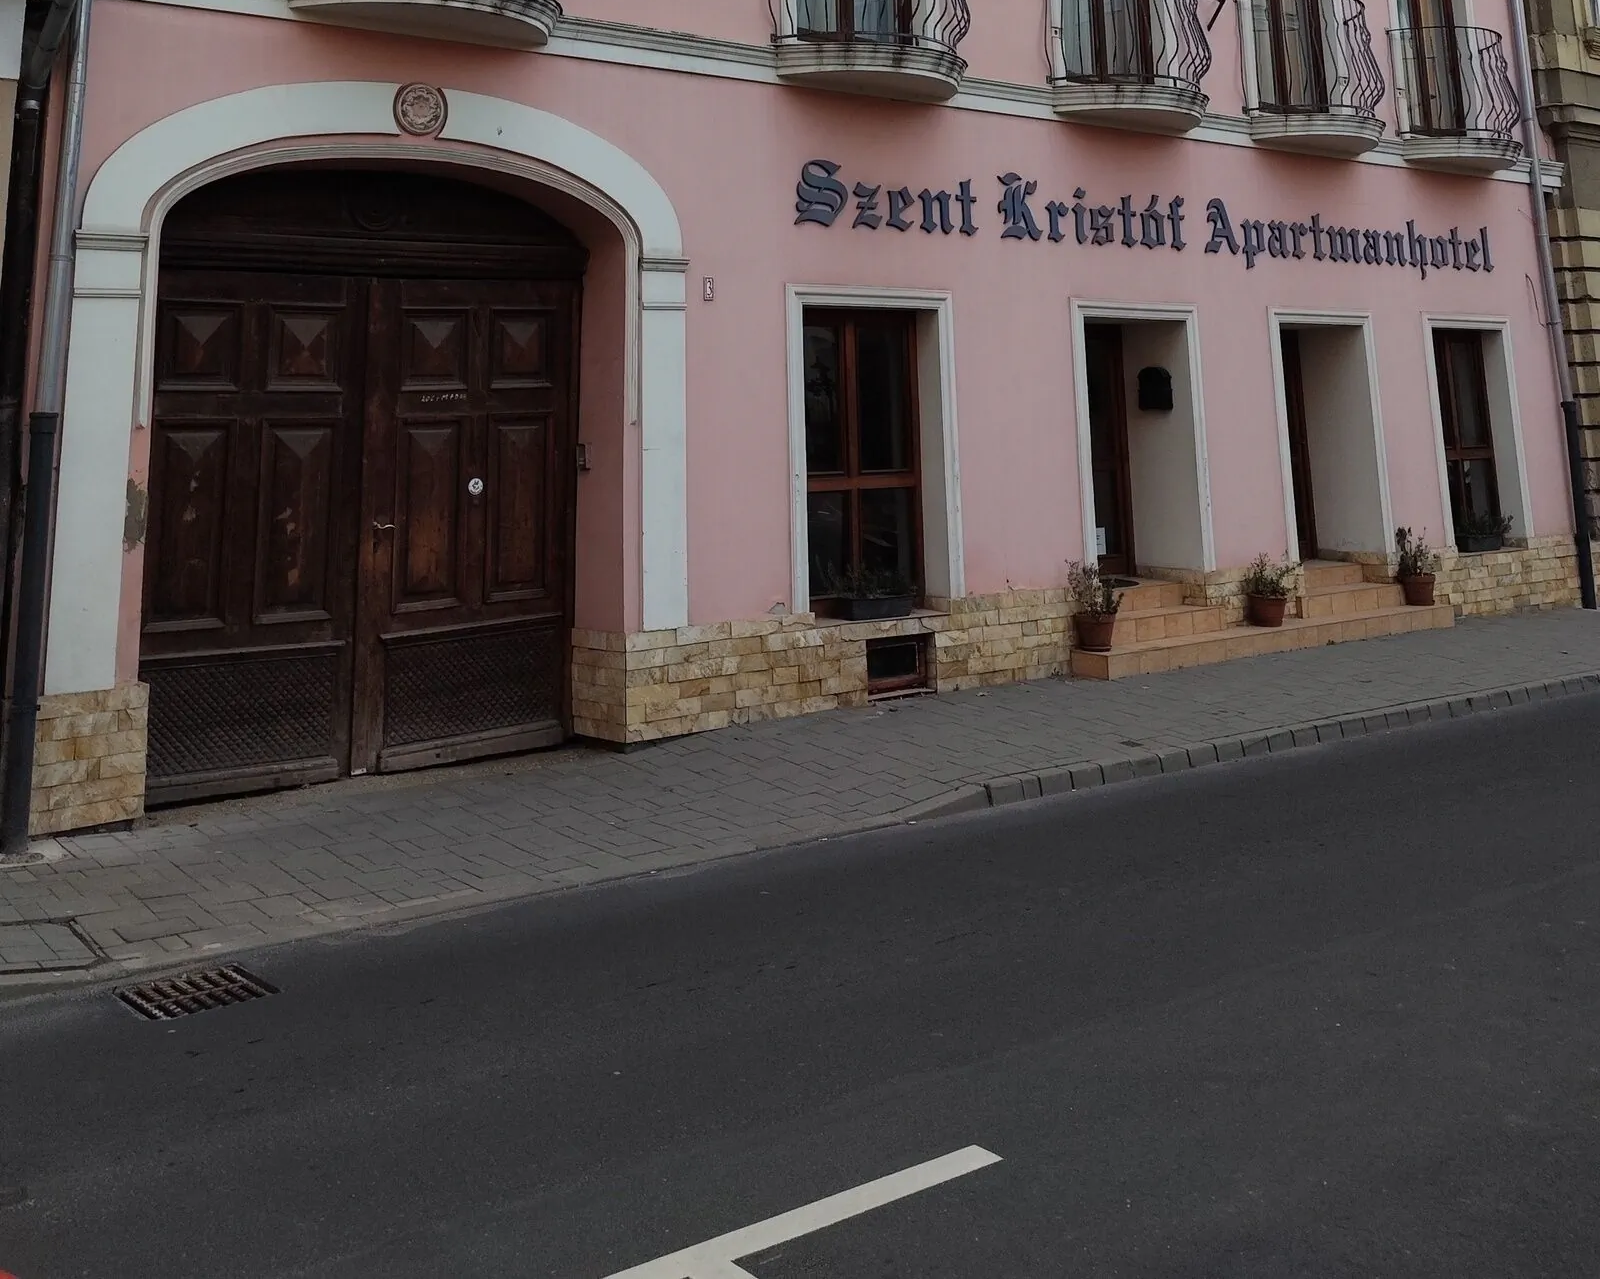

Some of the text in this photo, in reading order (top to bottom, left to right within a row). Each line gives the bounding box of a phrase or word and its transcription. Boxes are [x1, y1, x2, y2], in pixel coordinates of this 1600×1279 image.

[794, 159, 1494, 280] Szent Kristóf Apartmanhotel
